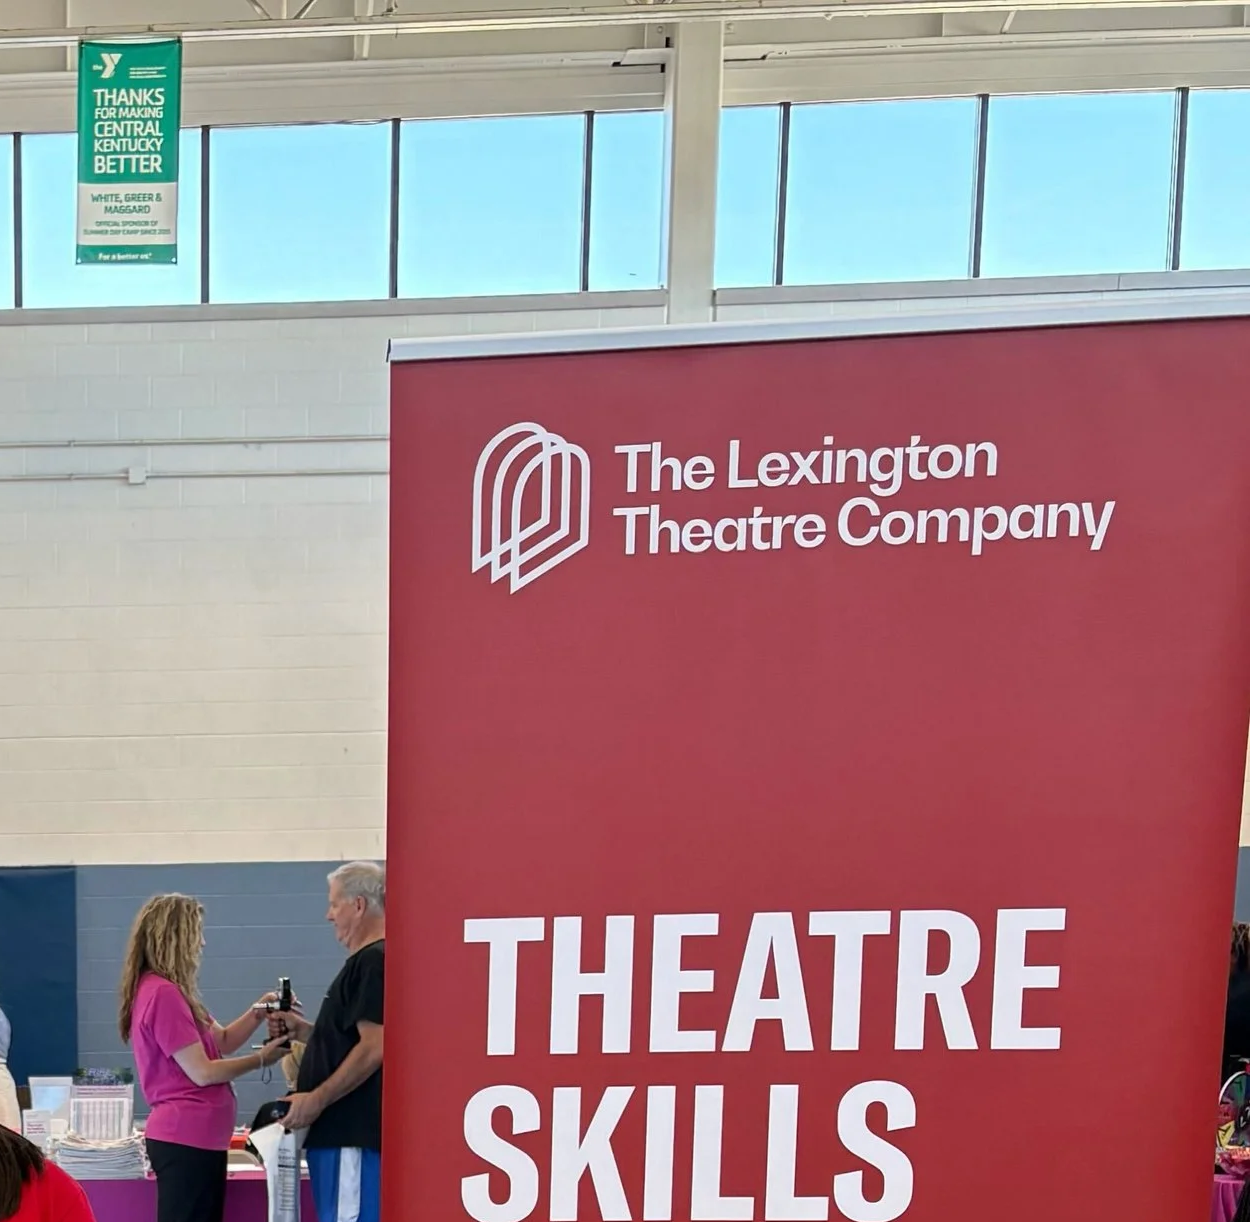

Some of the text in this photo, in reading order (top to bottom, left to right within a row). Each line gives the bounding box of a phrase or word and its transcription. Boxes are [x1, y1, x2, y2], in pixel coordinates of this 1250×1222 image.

[92, 88, 165, 106] THANKS
[94, 107, 164, 120] FOR MAKING
[94, 121, 164, 138] CENTRAL
[94, 138, 164, 152] KENTUCKY
[94, 154, 163, 174] BETTER
[91, 192, 162, 203] WHITE, GREER &
[104, 205, 151, 214] MAGGARD
[615, 435, 997, 497] The Lexington
[613, 497, 1116, 556] Theatre Company
[463, 908, 1067, 1056] THEATRE
